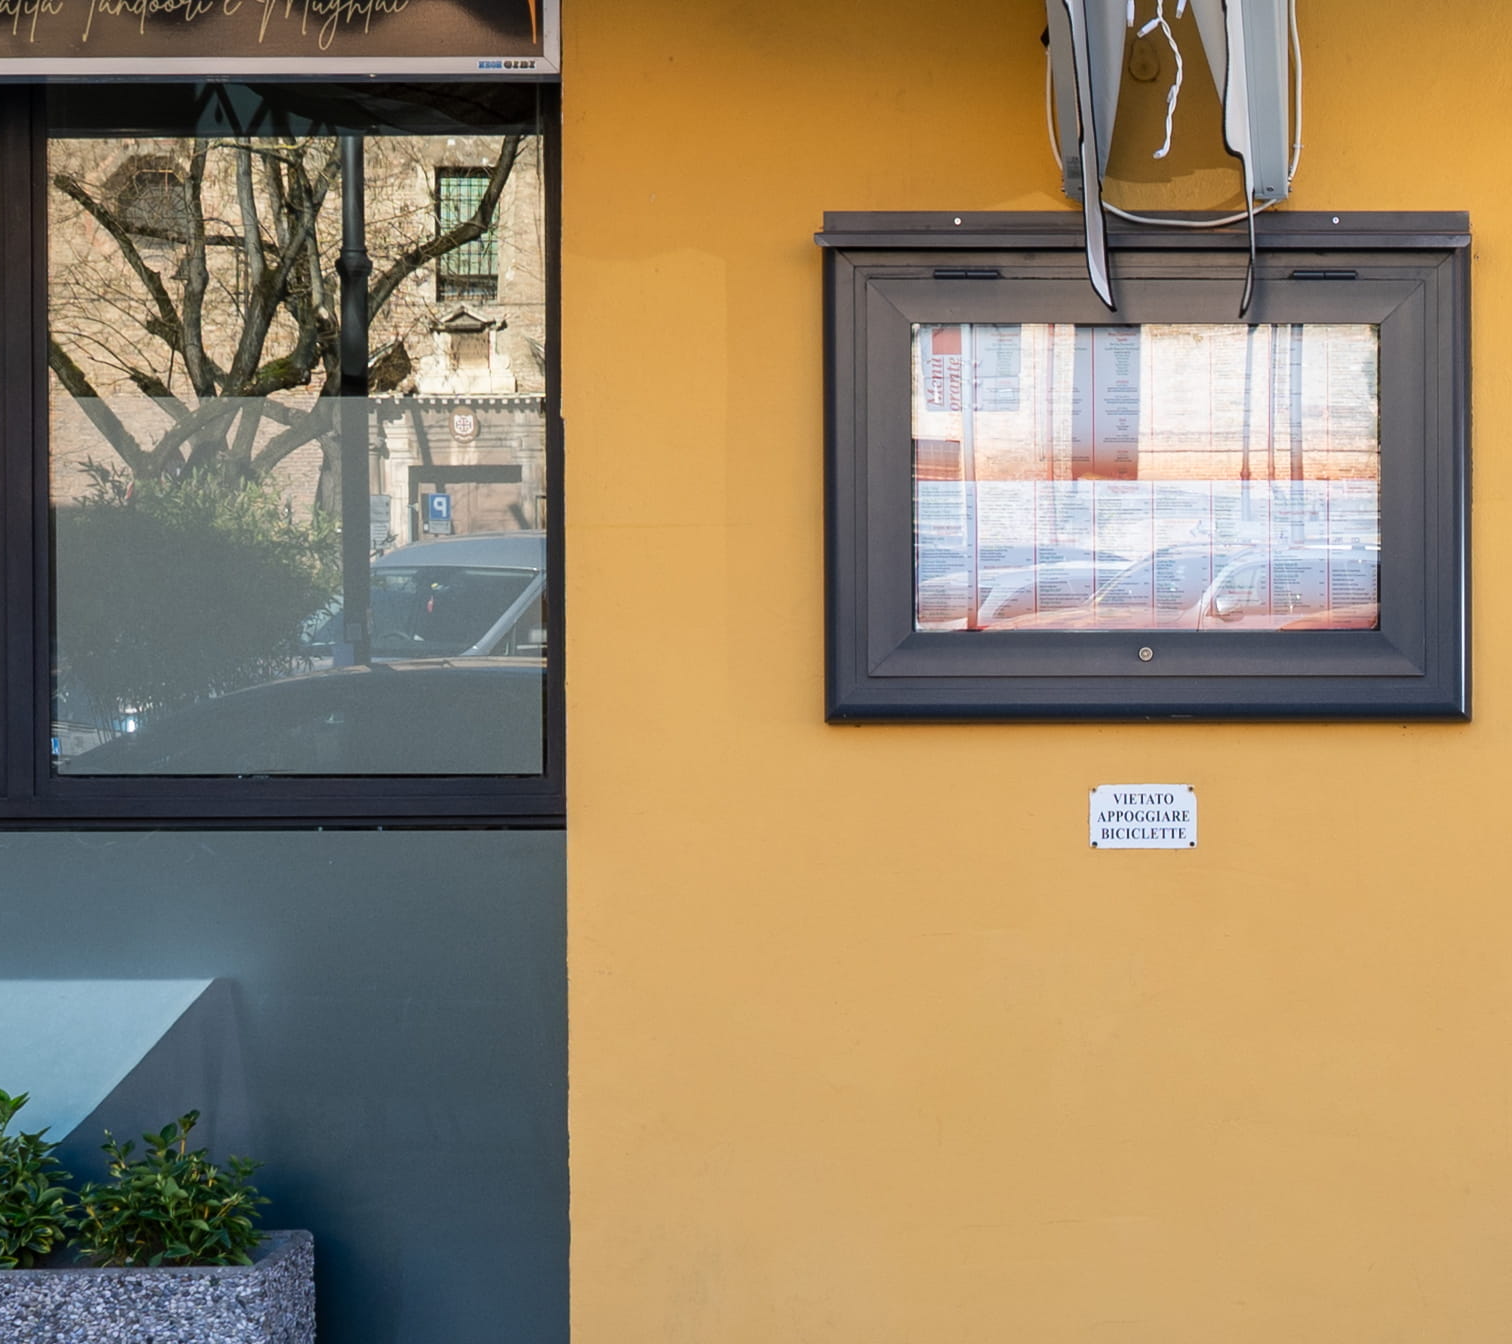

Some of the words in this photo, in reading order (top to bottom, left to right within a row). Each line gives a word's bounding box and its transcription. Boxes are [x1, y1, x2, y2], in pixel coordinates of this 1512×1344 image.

[1113, 793, 1175, 805] VIETATO
[1097, 810, 1190, 822] APPOGGIARE
[1101, 827, 1187, 840] BICICLETTE
